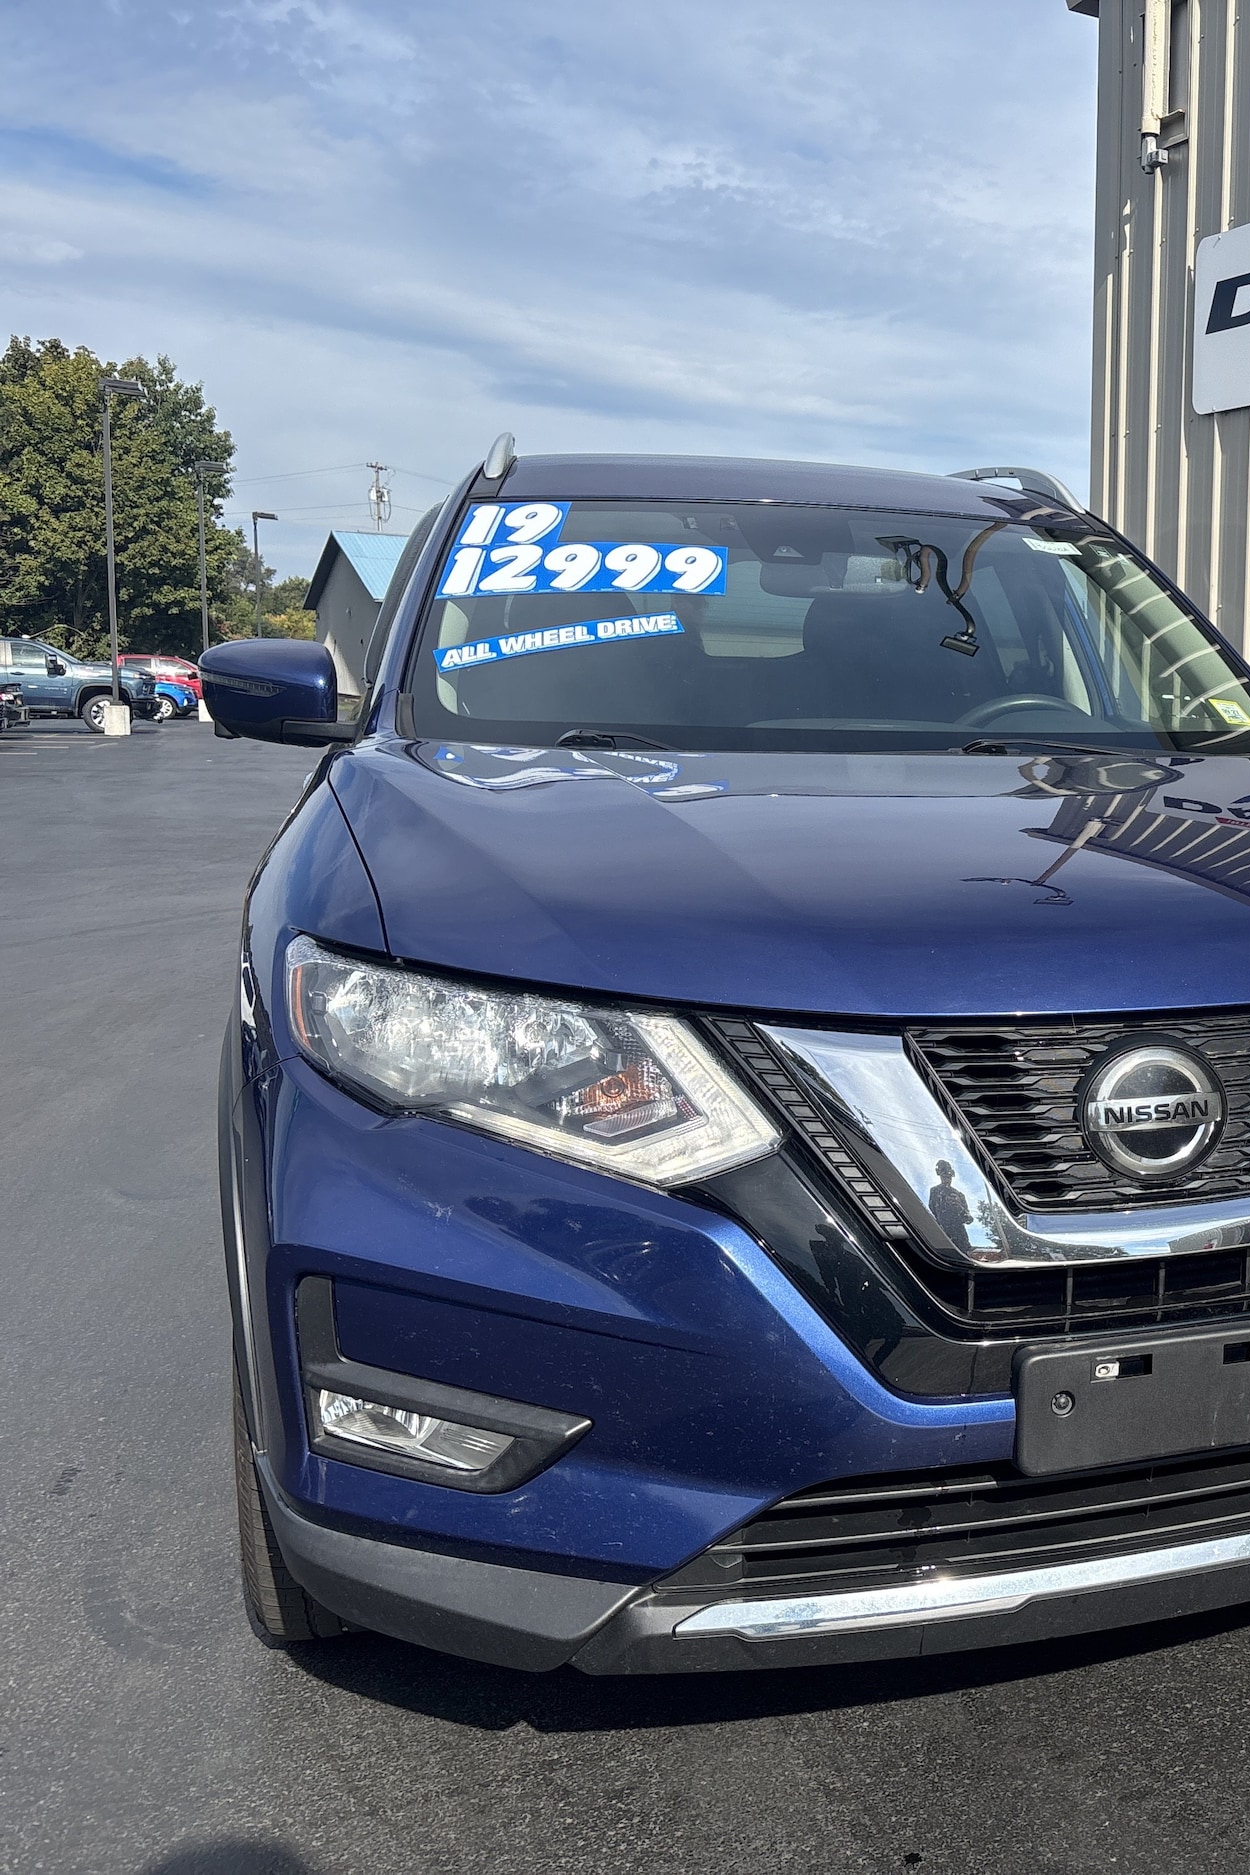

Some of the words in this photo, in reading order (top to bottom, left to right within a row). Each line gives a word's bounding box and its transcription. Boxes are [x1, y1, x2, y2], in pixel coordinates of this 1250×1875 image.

[460, 503, 563, 545] 19
[441, 543, 723, 593] 12999
[441, 642, 497, 668] ALL
[499, 625, 595, 656] WHEEL
[597, 614, 678, 639] DRIVE
[1104, 1100, 1208, 1124] NISSAN
